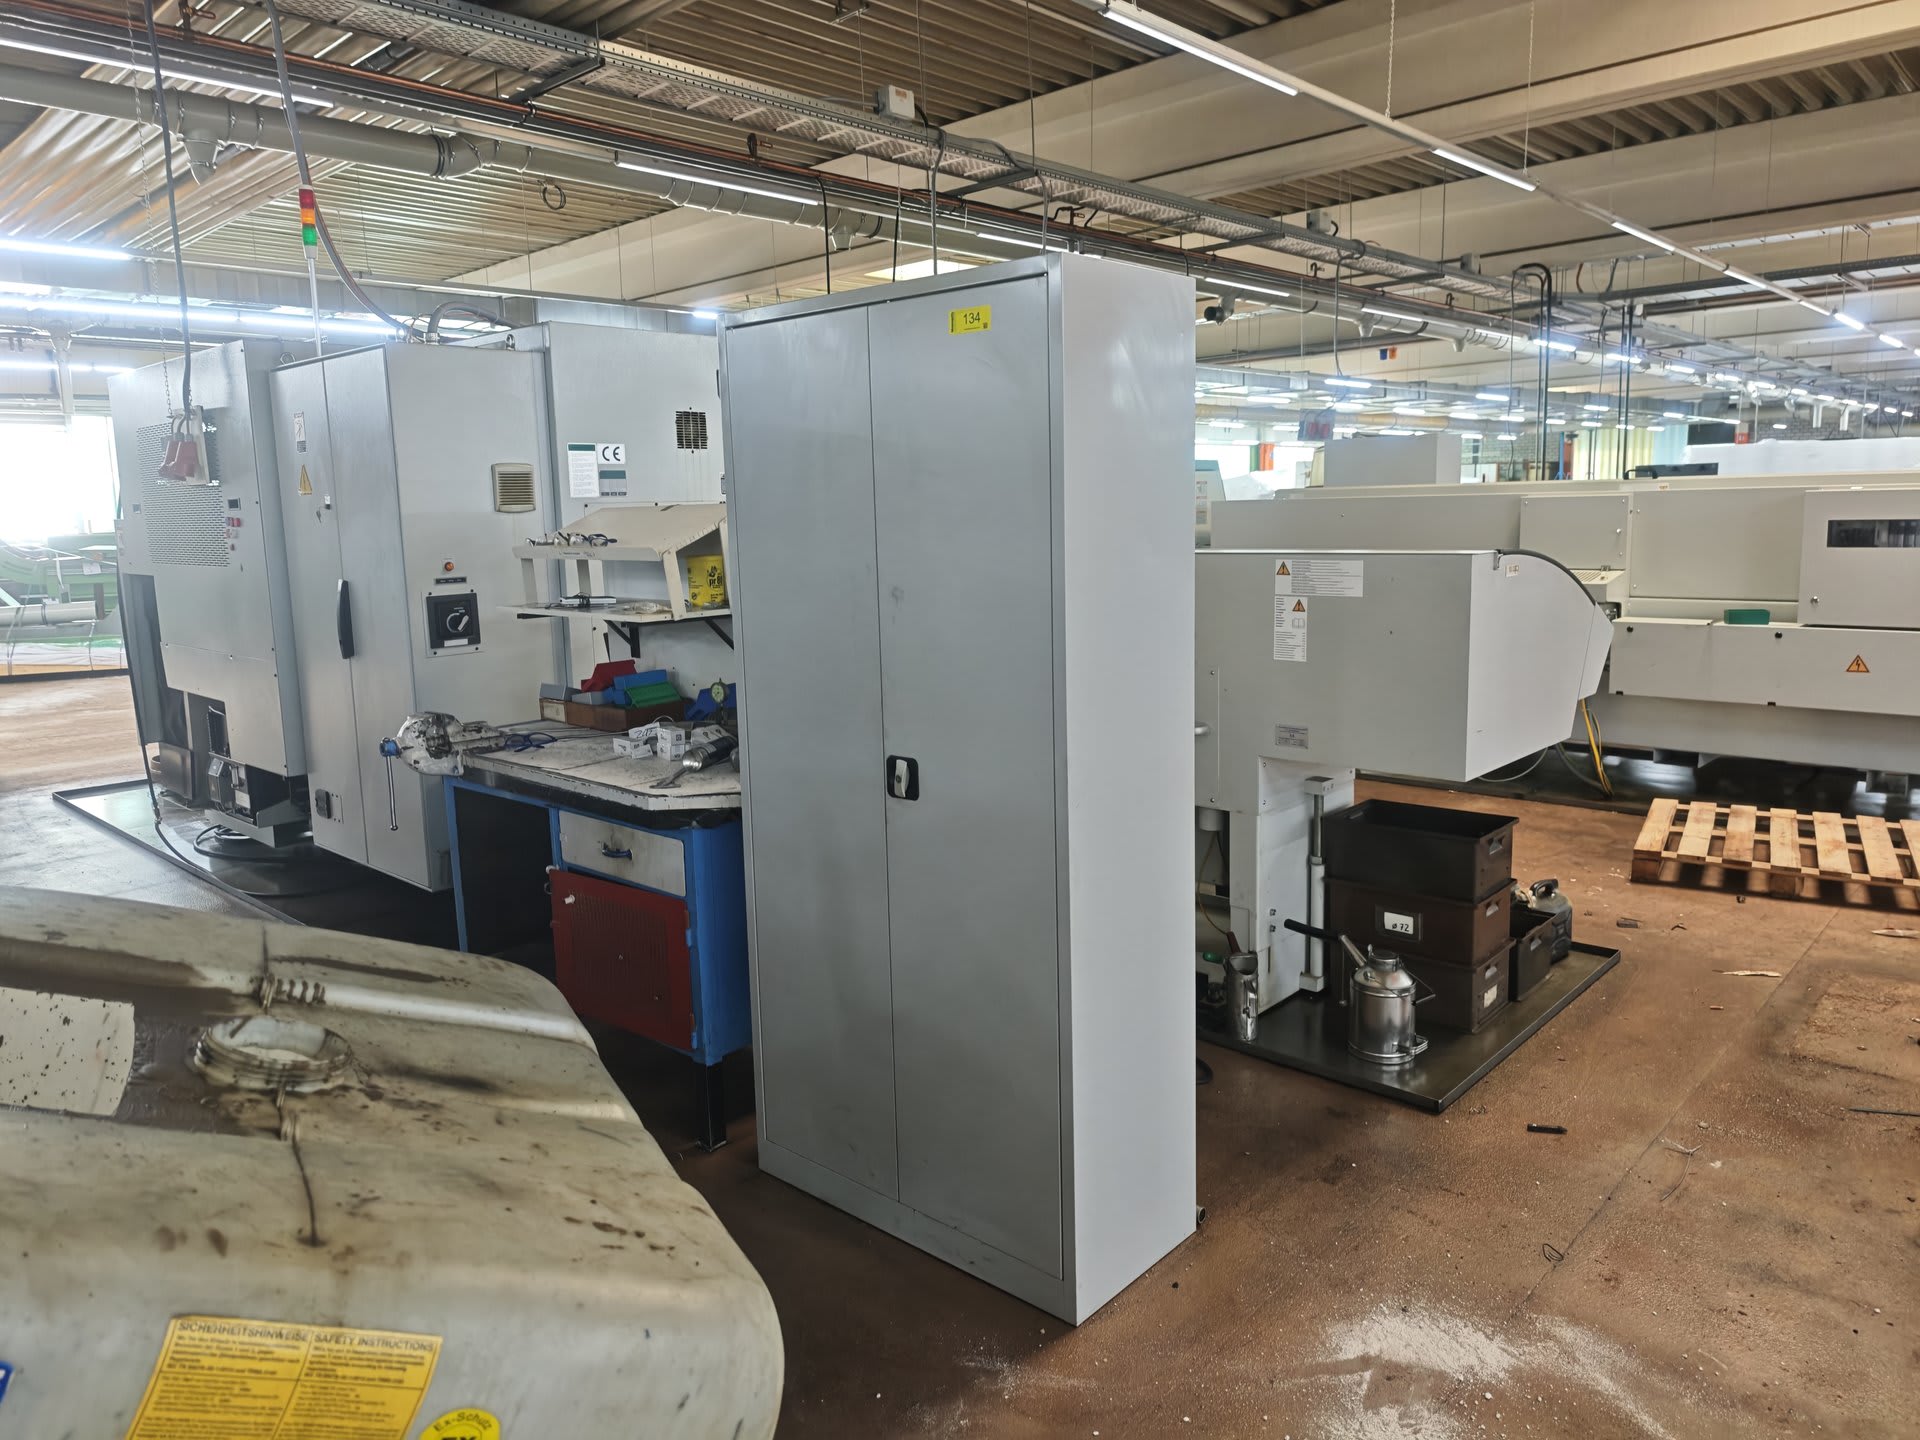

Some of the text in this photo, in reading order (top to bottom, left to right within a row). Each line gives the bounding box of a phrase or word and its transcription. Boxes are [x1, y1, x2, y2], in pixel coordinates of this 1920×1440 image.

[963, 312, 980, 324] 134
[602, 446, 621, 461] CE
[1399, 923, 1410, 932] 72
[178, 1322, 309, 1343] SICHERHEITSHINWEISE
[314, 1333, 434, 1352] SAFETY INSTRUCTIONS
